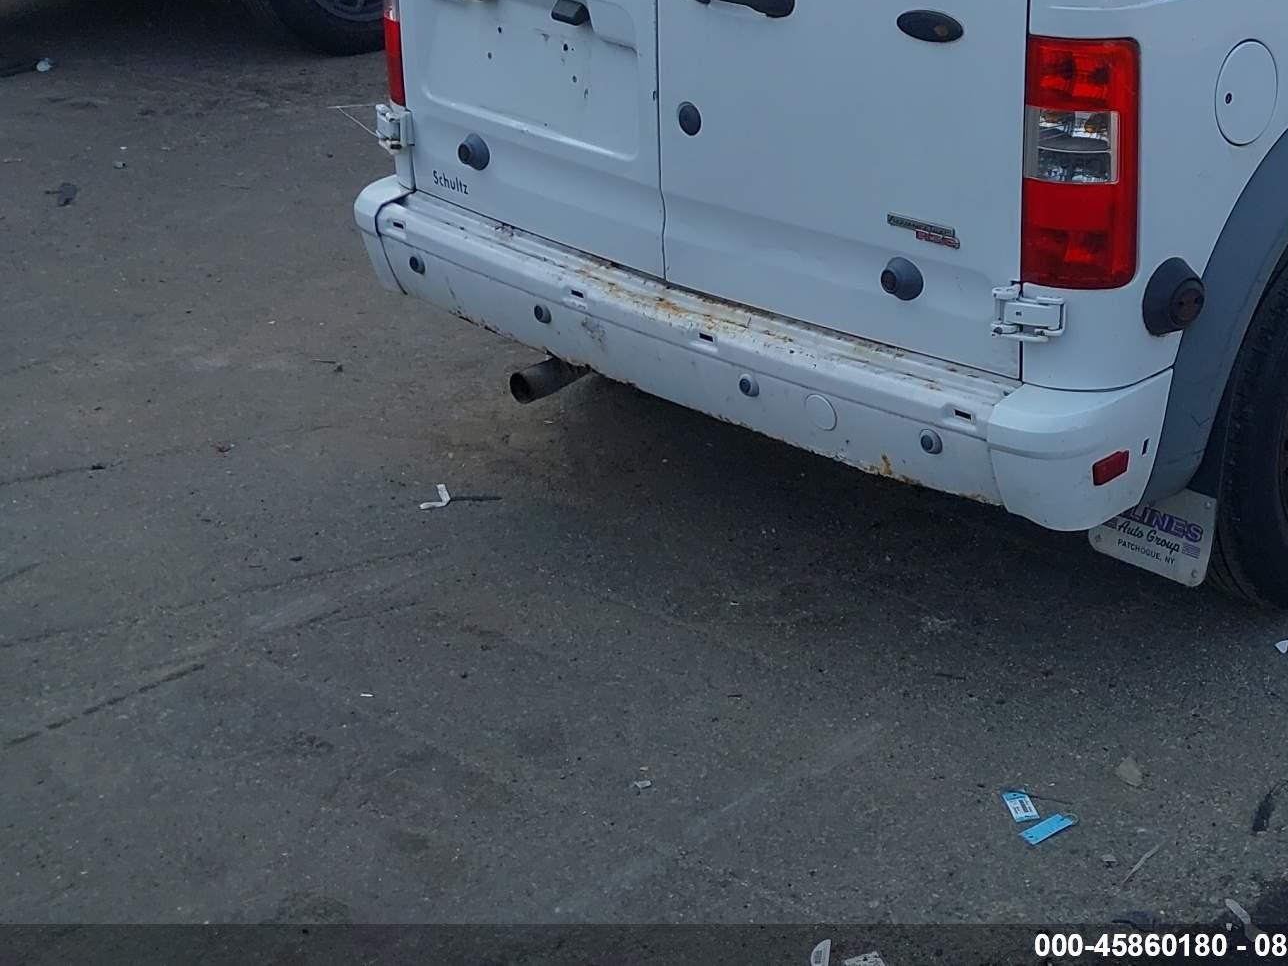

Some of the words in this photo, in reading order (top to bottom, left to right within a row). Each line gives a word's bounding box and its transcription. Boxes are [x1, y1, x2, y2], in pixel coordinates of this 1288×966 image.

[432, 169, 468, 195] Schultz
[1117, 520, 1144, 539] Auto
[1145, 529, 1180, 555] Group
